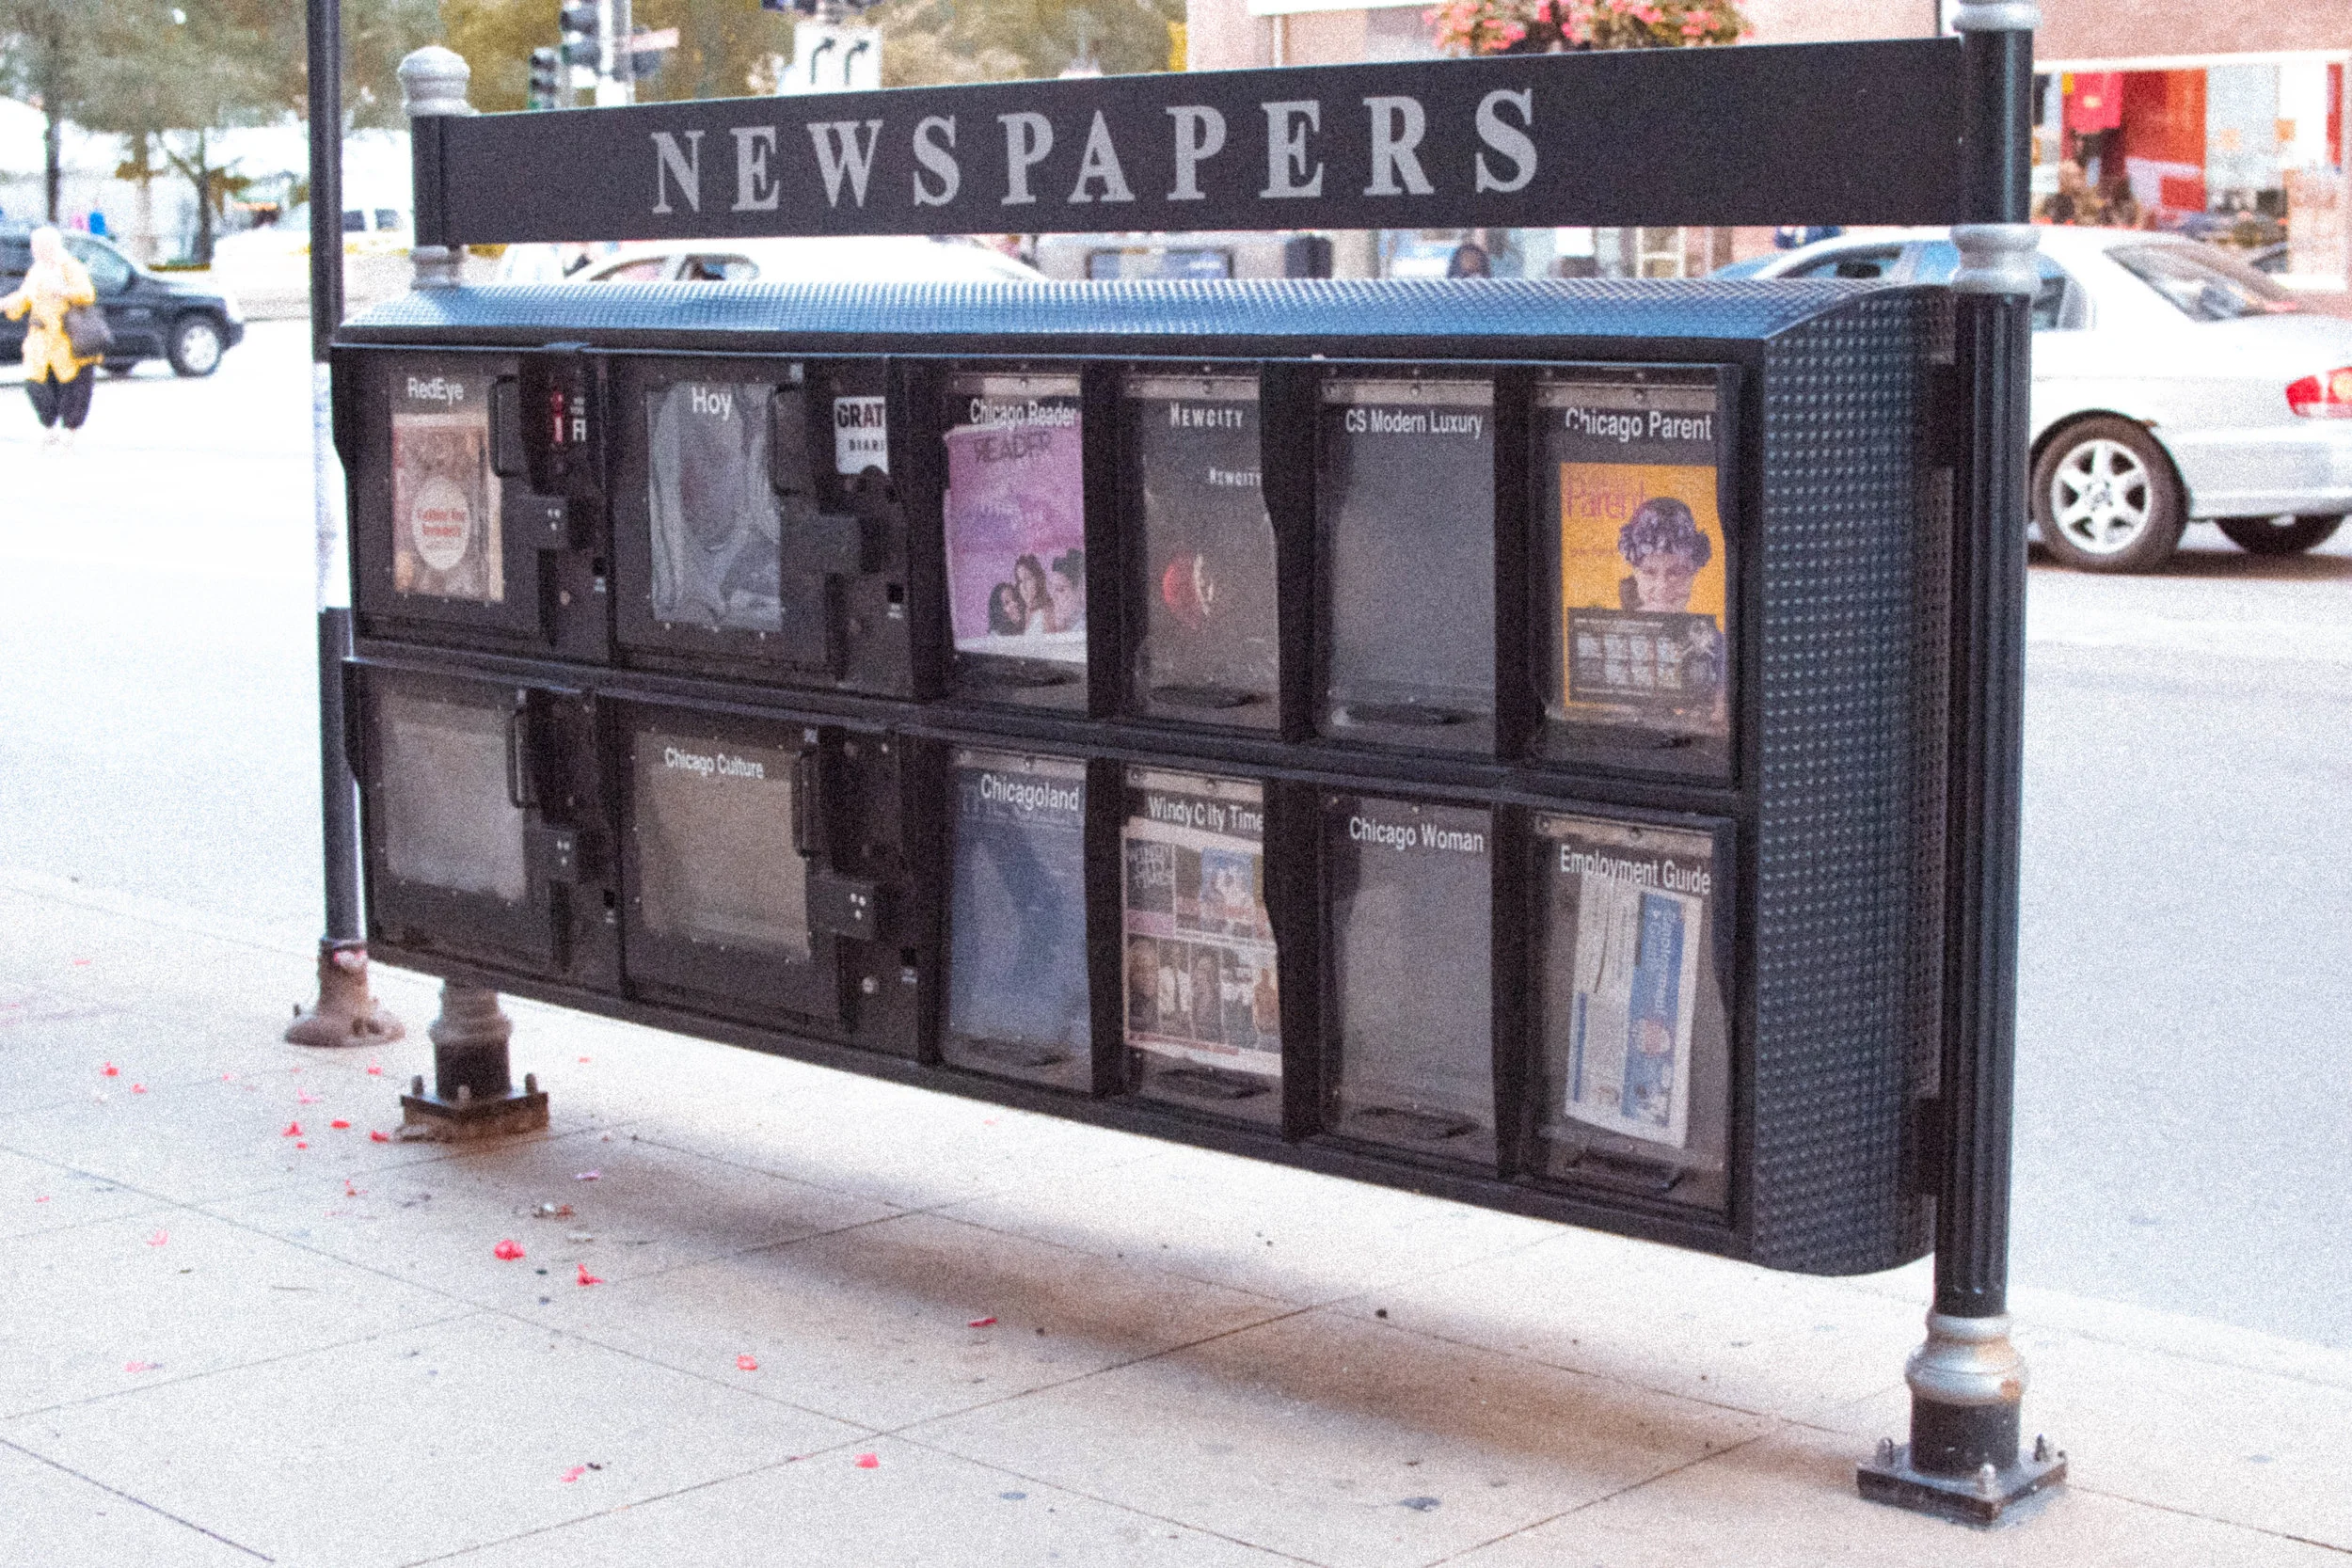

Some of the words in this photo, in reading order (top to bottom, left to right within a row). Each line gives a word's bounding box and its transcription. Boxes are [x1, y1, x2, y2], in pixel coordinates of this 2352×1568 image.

[650, 89, 1538, 214] NEWSPAPERS
[406, 377, 465, 404] RedEye
[691, 388, 733, 419] Hoy
[970, 399, 1025, 430] Chicago
[1028, 402, 1077, 427] Reader
[1344, 410, 1367, 433] CS
[1370, 410, 1427, 435] Modern
[1430, 411, 1484, 439] Luxury
[1565, 407, 1643, 442] Chicago
[1648, 411, 1712, 441] Parent
[664, 747, 715, 777] Chicago
[717, 752, 765, 781] Culture
[980, 773, 1080, 812] Chicagoland
[1148, 796, 1193, 830] Windy
[1349, 816, 1417, 849] Chicago
[1421, 823, 1484, 853] Woman
[1560, 845, 1660, 887] Employment
[1662, 860, 1712, 895] Guide
